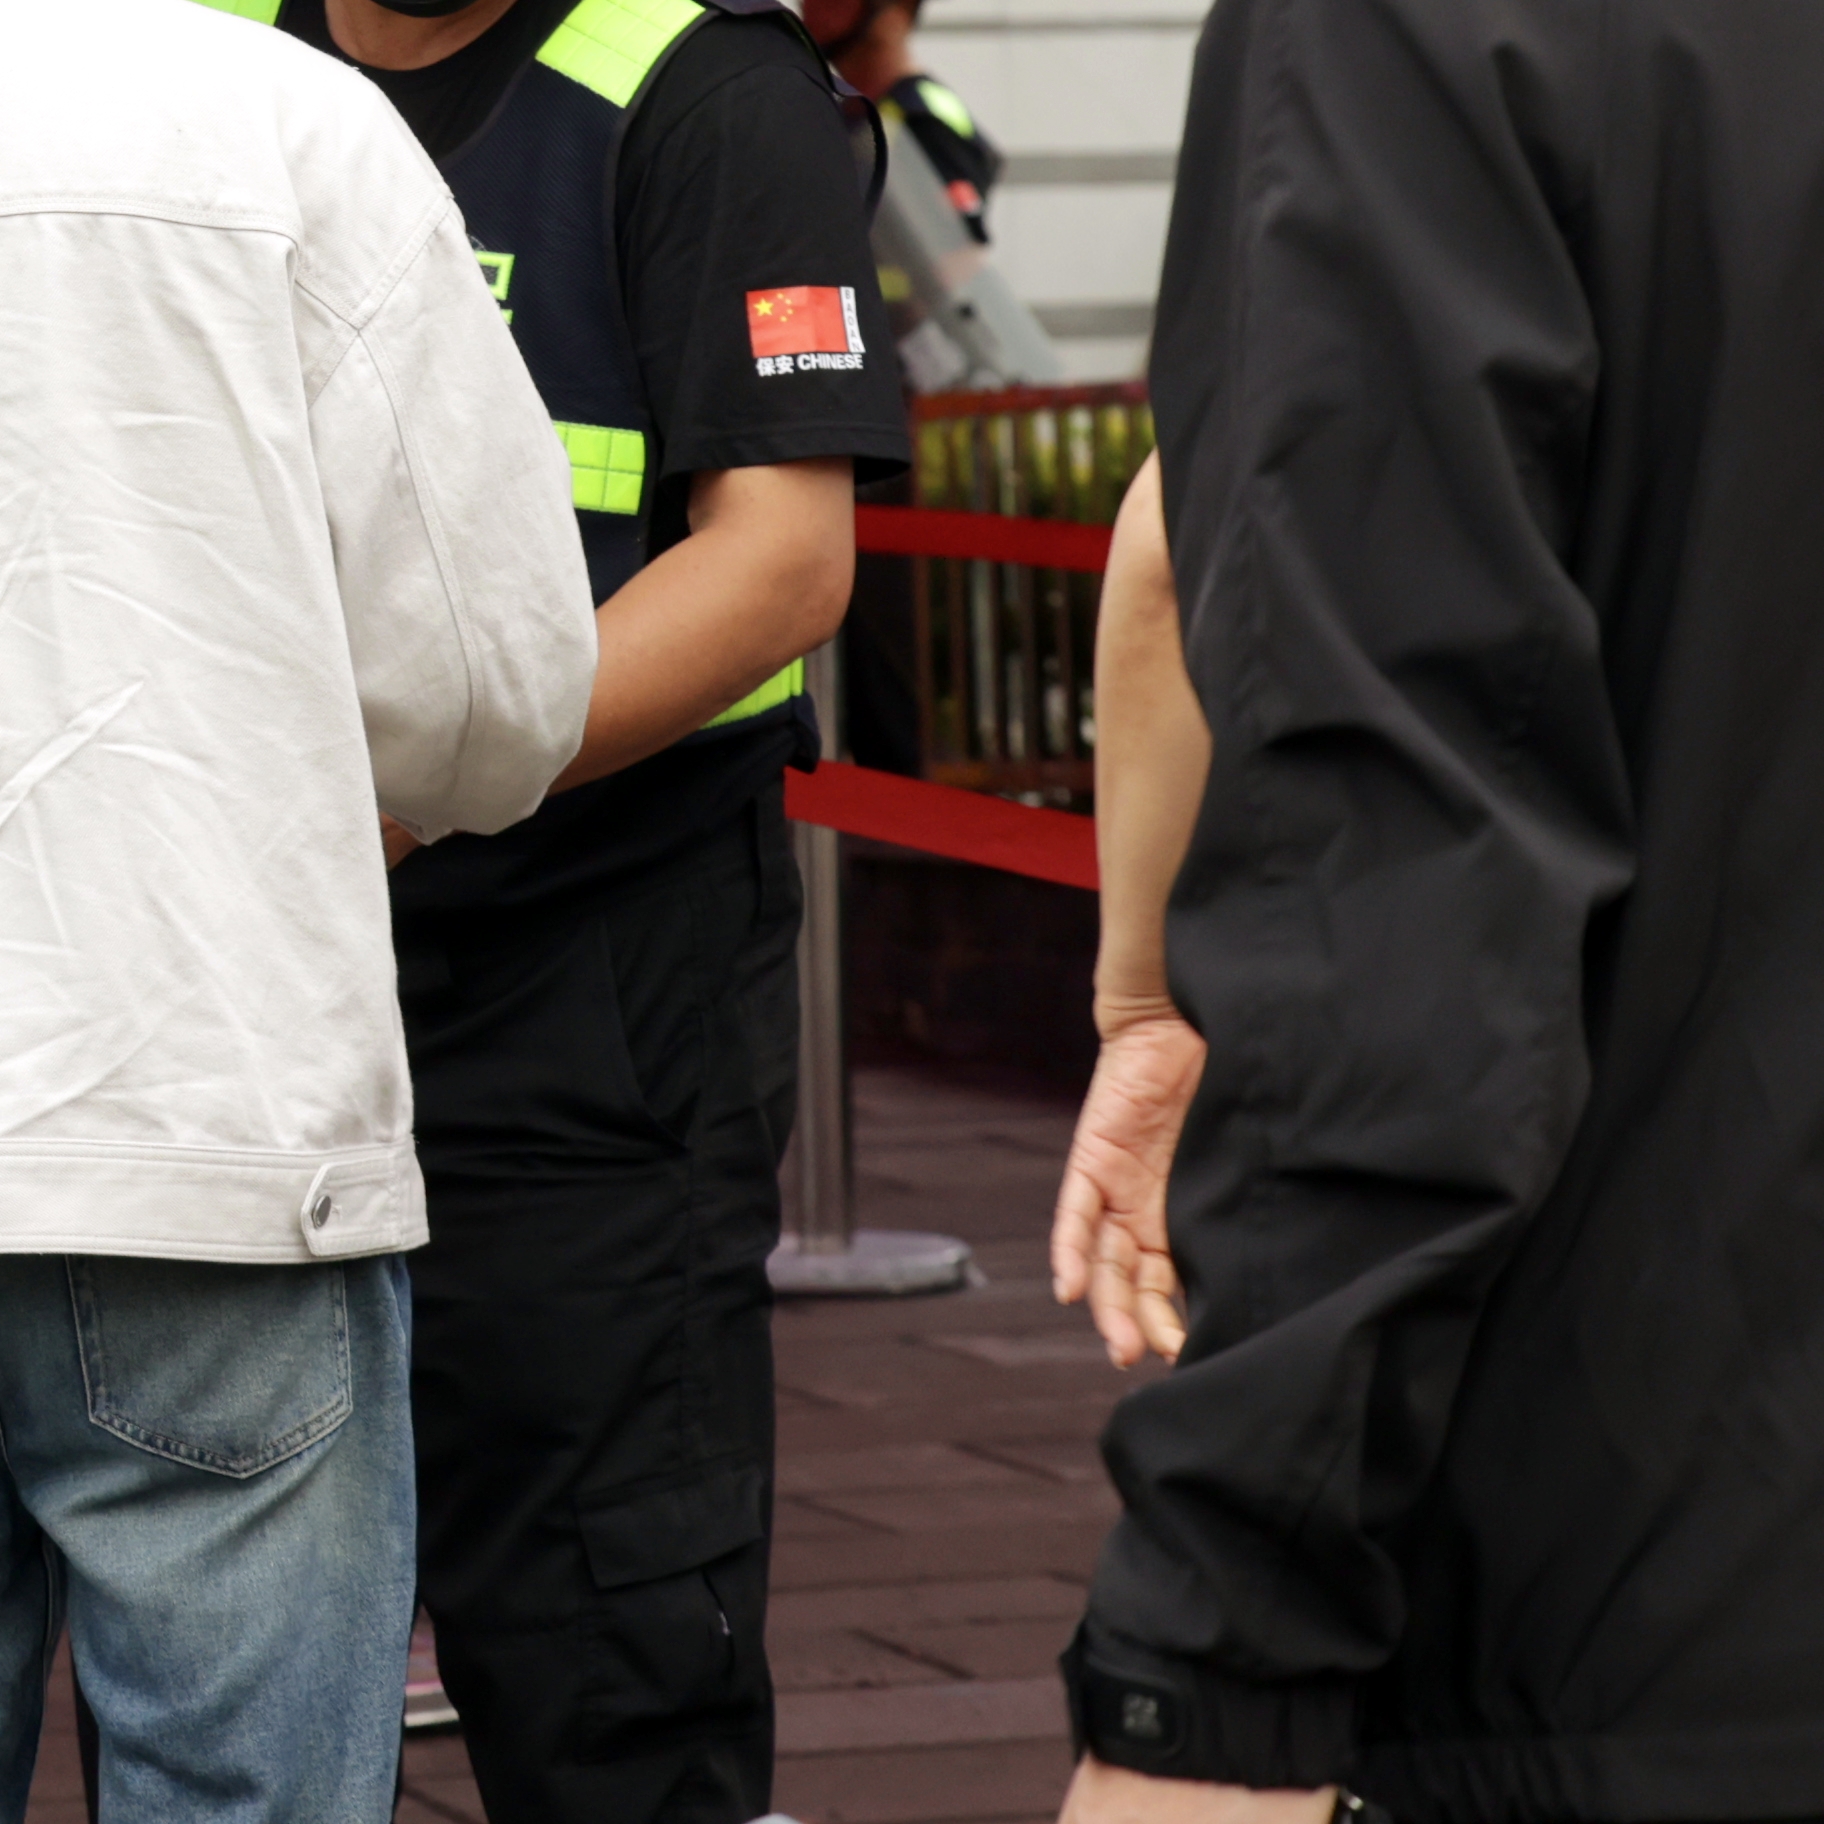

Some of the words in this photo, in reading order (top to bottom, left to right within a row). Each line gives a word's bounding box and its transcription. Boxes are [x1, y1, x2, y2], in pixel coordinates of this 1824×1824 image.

[844, 289, 861, 352] BAOAN
[756, 355, 795, 377] 保安
[797, 353, 864, 371] CHINESE
